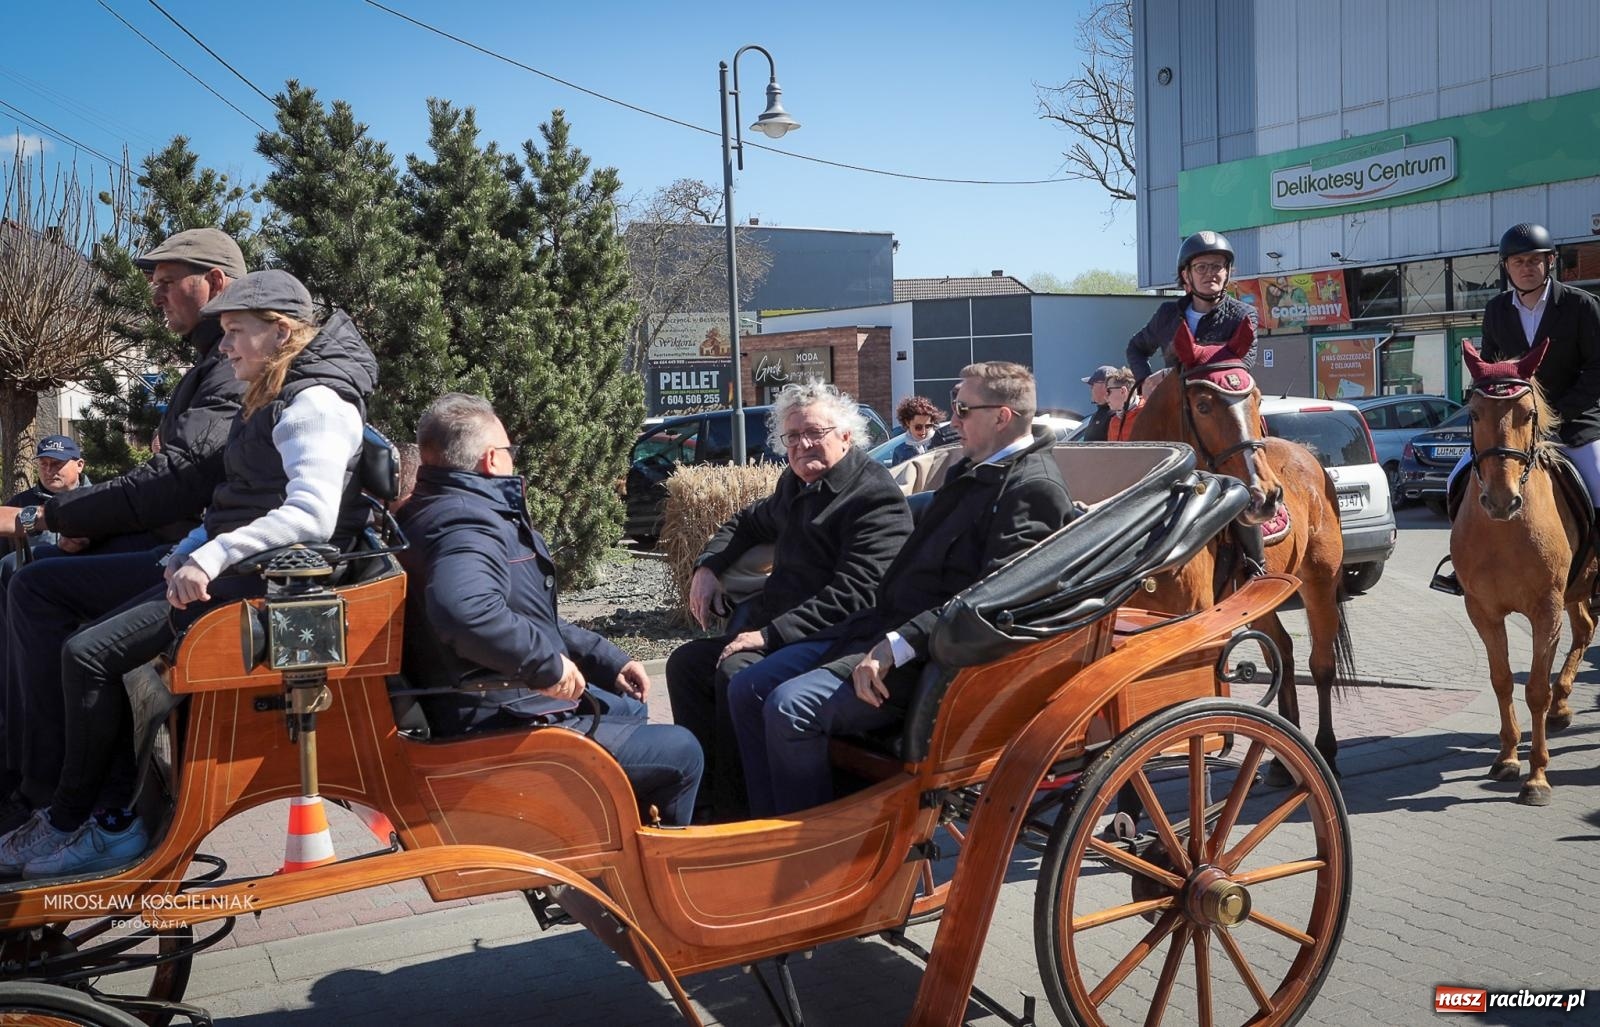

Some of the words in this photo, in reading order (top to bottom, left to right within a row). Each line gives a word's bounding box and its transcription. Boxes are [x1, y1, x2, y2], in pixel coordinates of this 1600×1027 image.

[1277, 169, 1364, 198] Delikatesy
[1368, 155, 1446, 182] Centrum
[653, 336, 697, 348] Wiktoria
[796, 352, 819, 362] MODA
[659, 370, 720, 390] PELLET
[667, 395, 684, 405] 604
[685, 395, 702, 404] 506
[703, 394, 720, 404] 255
